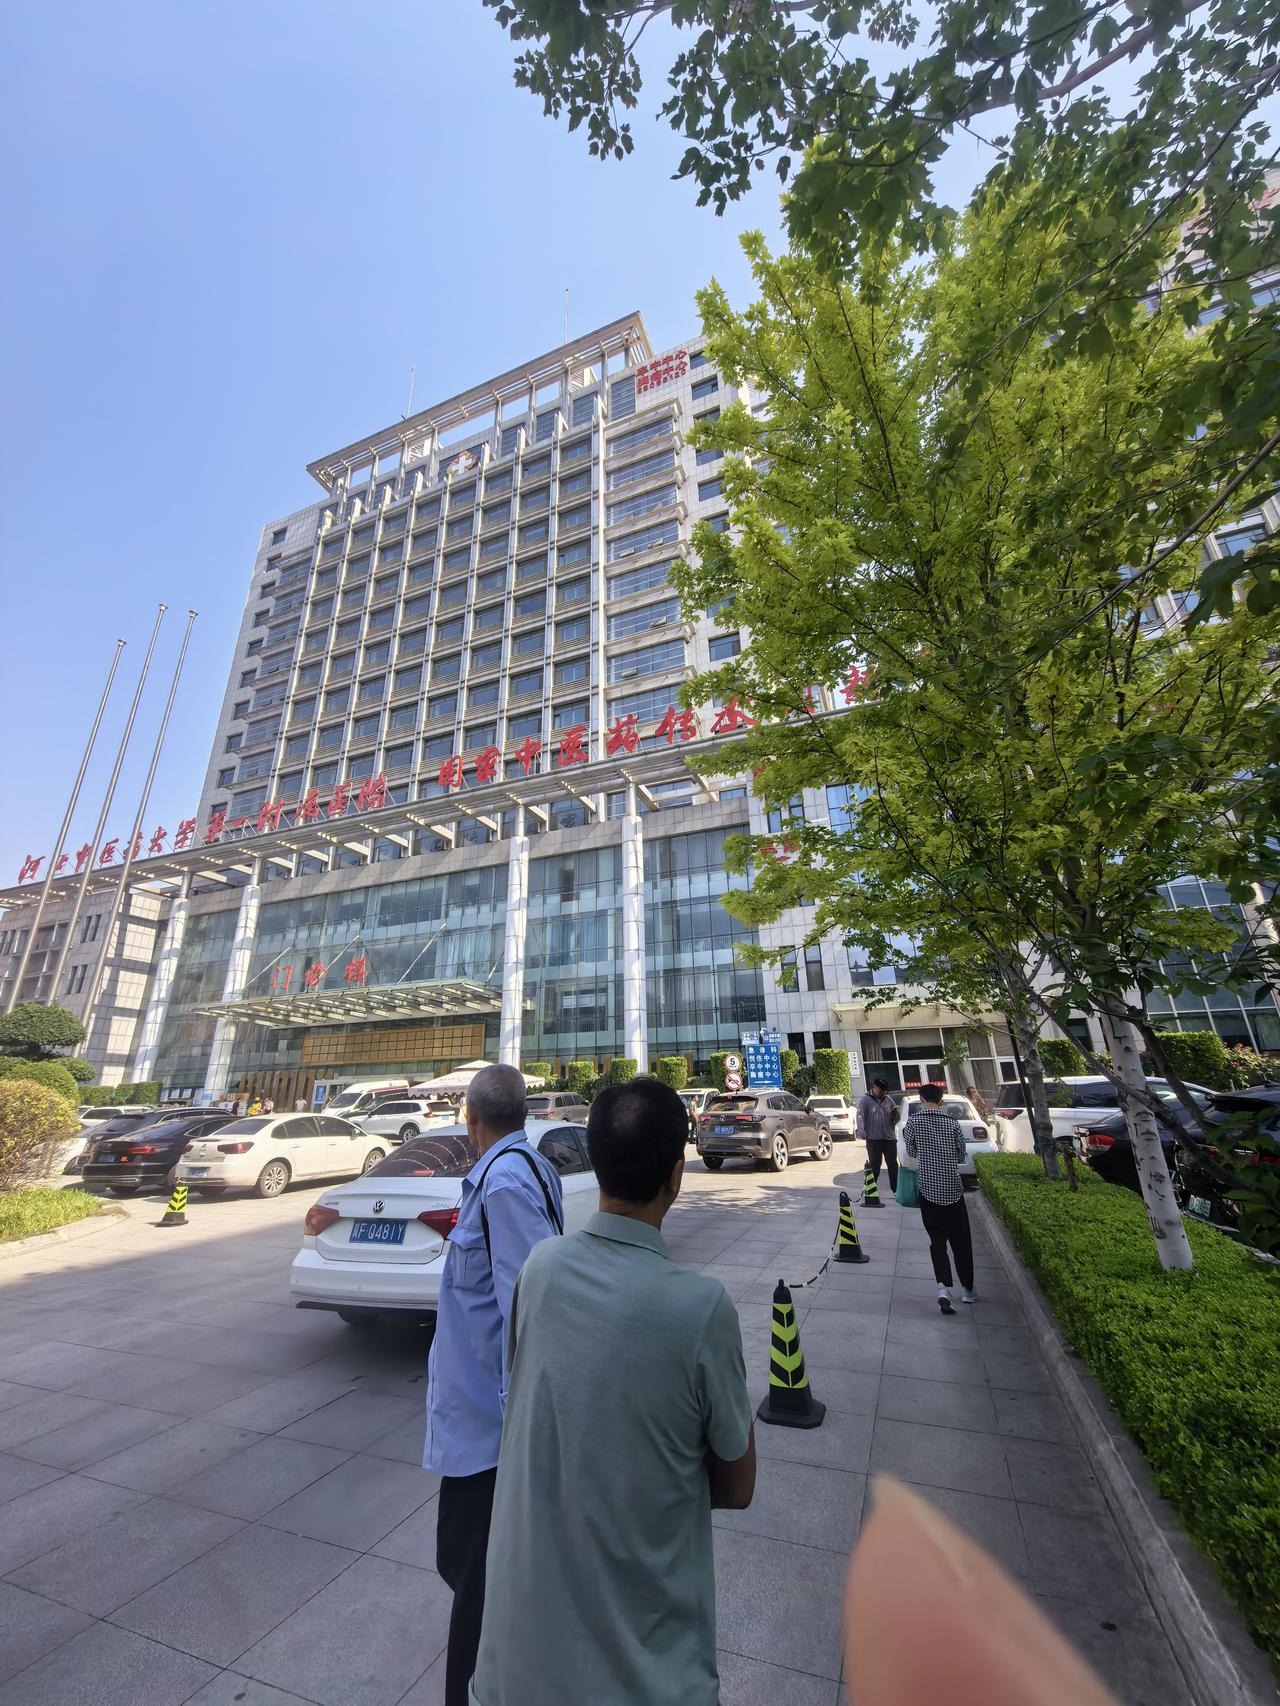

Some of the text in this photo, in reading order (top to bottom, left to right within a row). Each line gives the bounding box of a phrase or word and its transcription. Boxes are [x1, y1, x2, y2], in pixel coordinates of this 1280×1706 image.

[272, 955, 368, 990] 门诊楼
[748, 1046, 777, 1054] 急诊科
[730, 1057, 736, 1066] 5
[749, 1054, 778, 1062] 创伤中心
[750, 1062, 778, 1070] 卒中中心
[750, 1070, 779, 1079] 胸痛中心
